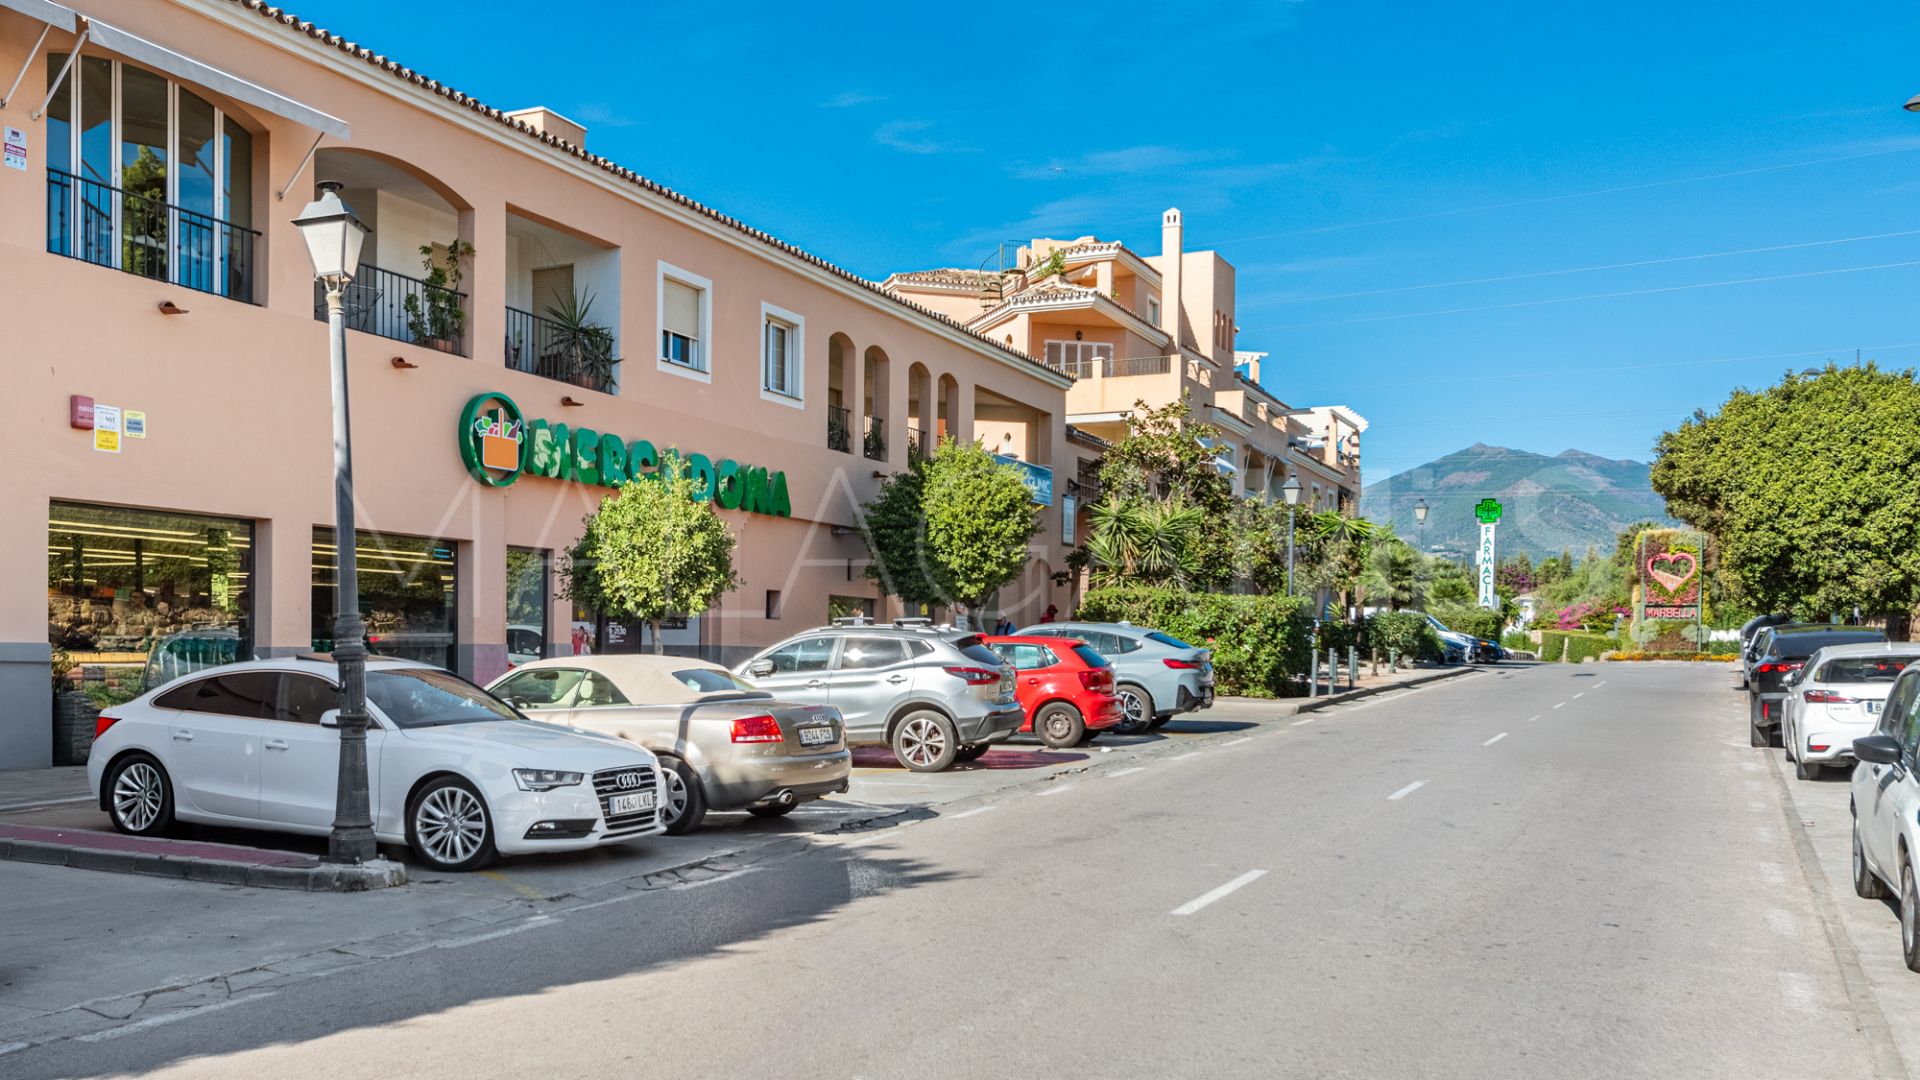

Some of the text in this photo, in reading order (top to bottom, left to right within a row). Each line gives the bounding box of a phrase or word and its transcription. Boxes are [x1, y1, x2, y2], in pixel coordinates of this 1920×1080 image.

[1481, 526, 1493, 605] FARMACIA
[1645, 607, 1698, 619] MARBELLA
[637, 794, 652, 808] LKL
